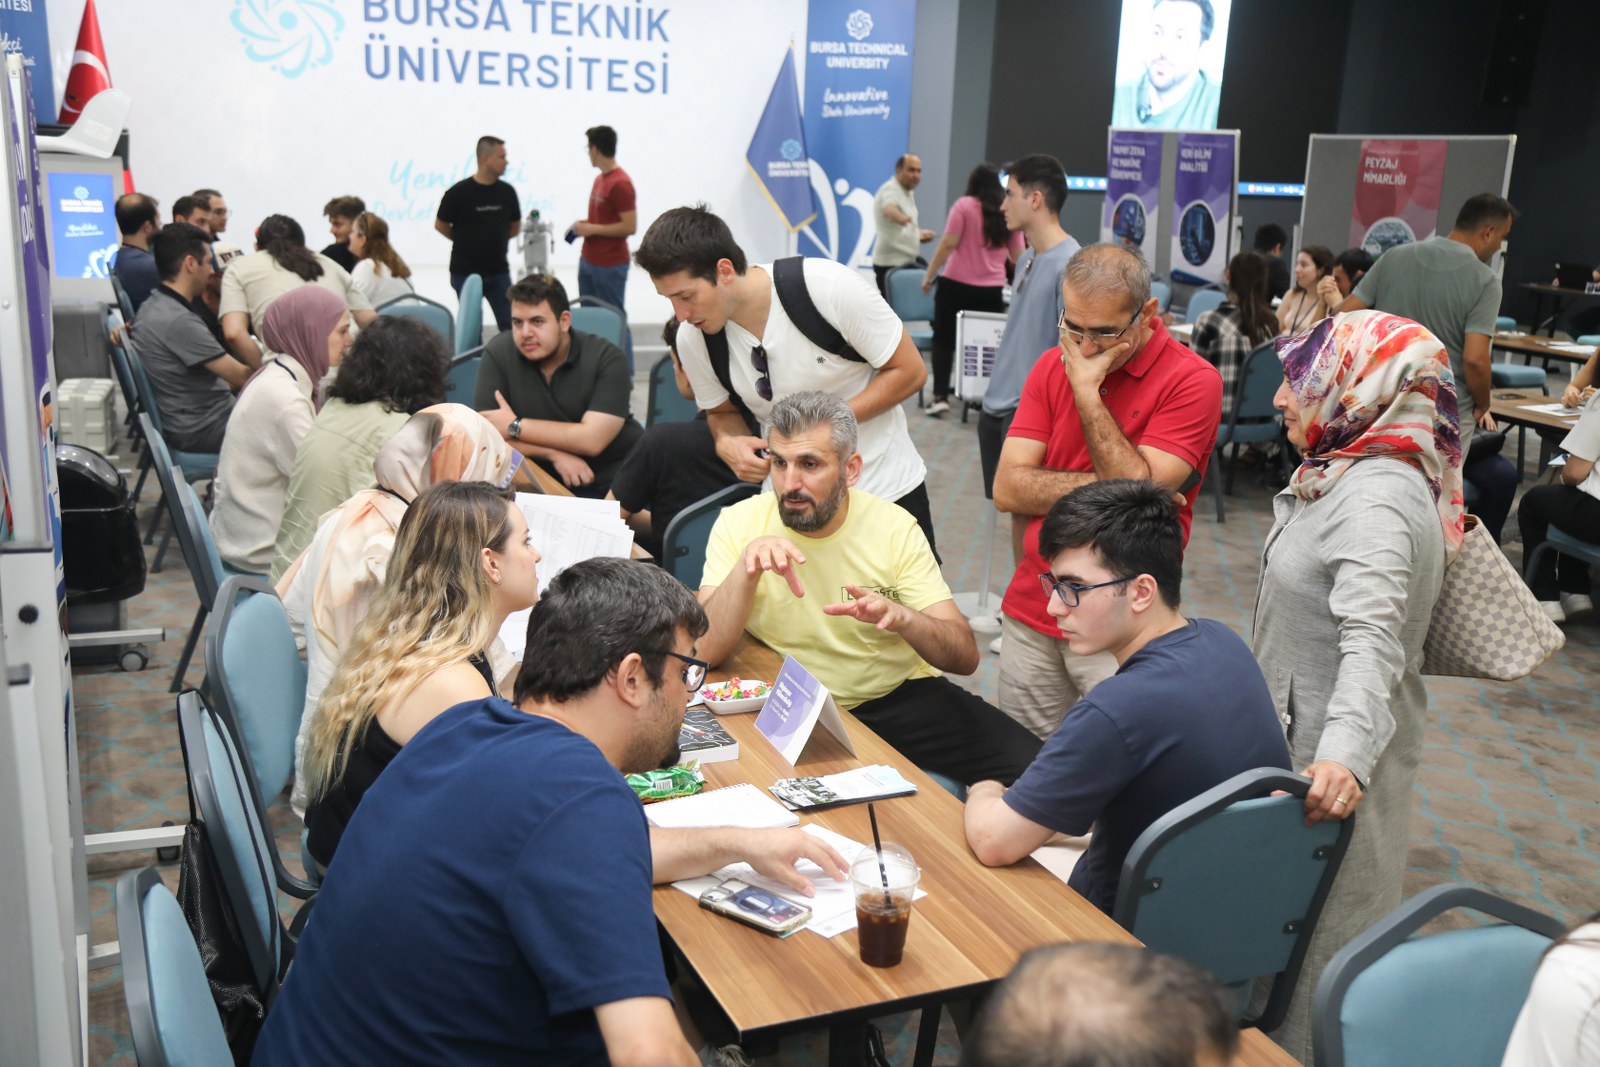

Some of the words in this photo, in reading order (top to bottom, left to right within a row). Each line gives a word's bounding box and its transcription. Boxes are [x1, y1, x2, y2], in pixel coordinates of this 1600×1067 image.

[364, 0, 511, 31] BURSA
[522, 0, 670, 42] TEKNİK
[810, 41, 847, 54] BURSA
[847, 42, 908, 56] TECHNICAL
[364, 33, 669, 95] ÜNİVERSİTESİ
[826, 56, 889, 70] UNIVERSITY
[824, 86, 888, 103] Innovative
[1365, 156, 1399, 170] PEYZAJ
[1363, 171, 1407, 186] MİMARLIĞI
